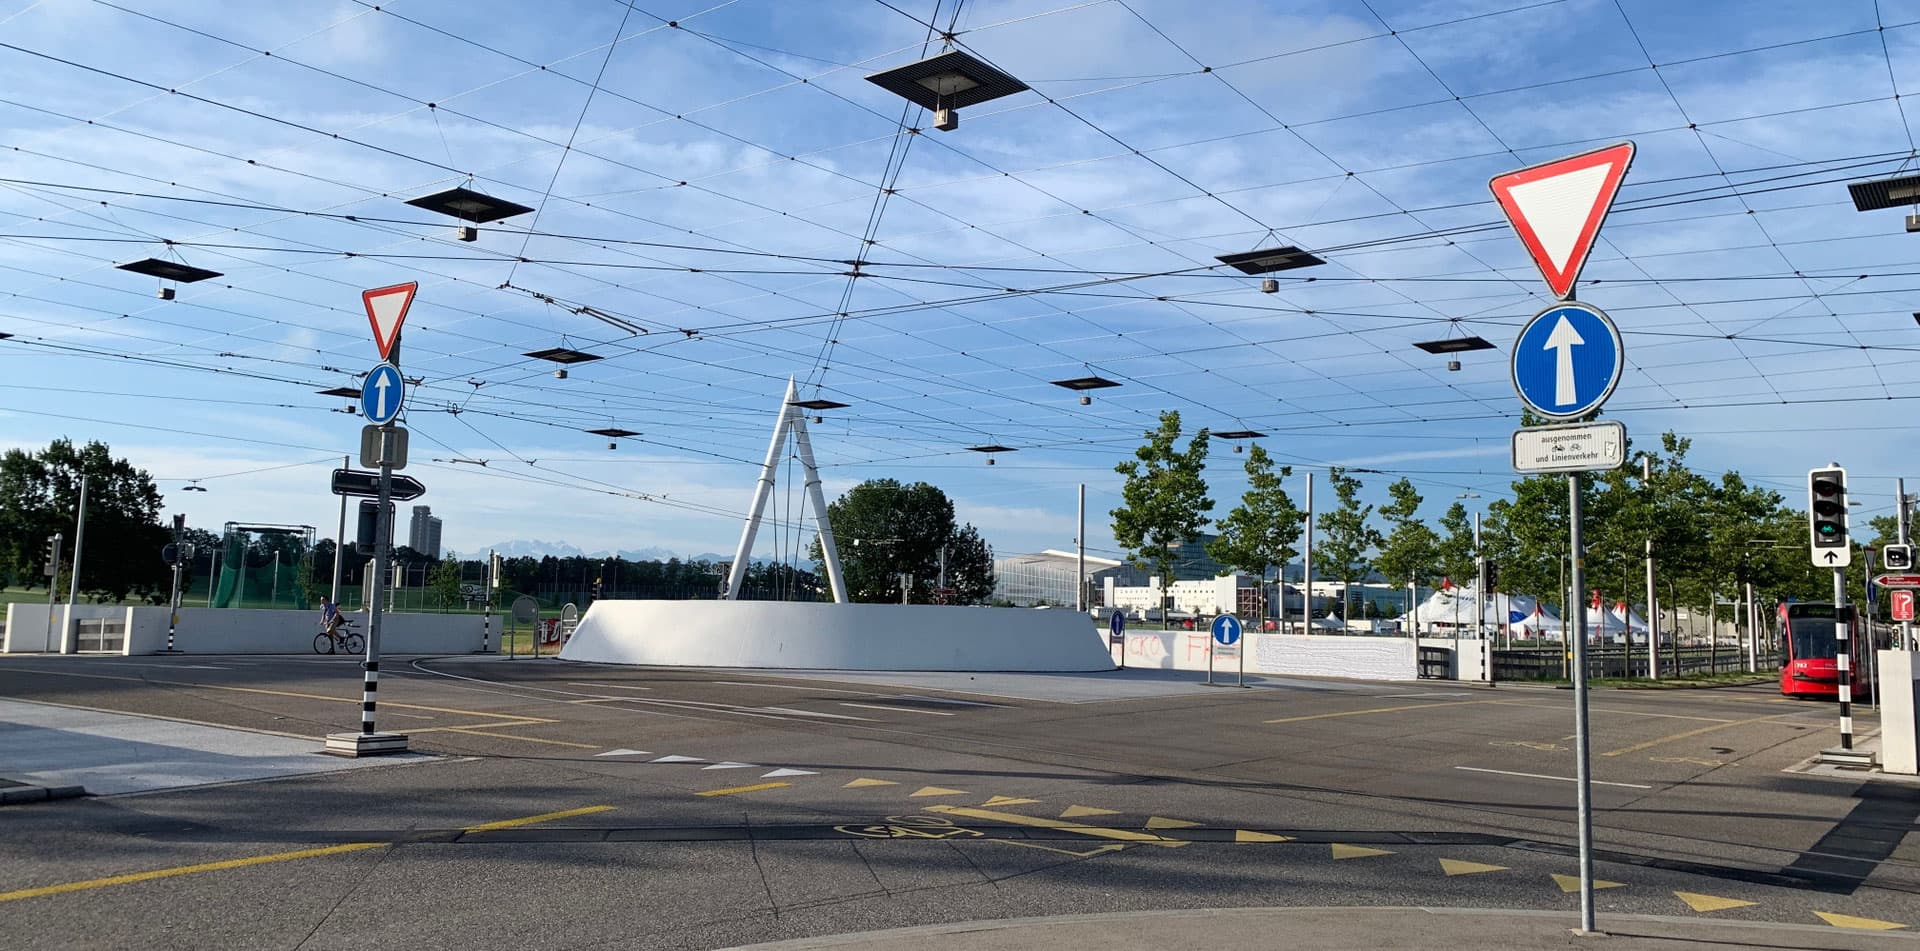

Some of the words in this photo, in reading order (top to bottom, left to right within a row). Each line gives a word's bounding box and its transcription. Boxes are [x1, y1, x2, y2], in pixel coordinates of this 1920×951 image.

[1541, 433, 1592, 444] ausgenommen
[1535, 455, 1549, 463] und
[1551, 450, 1598, 462] Linienverkehr
